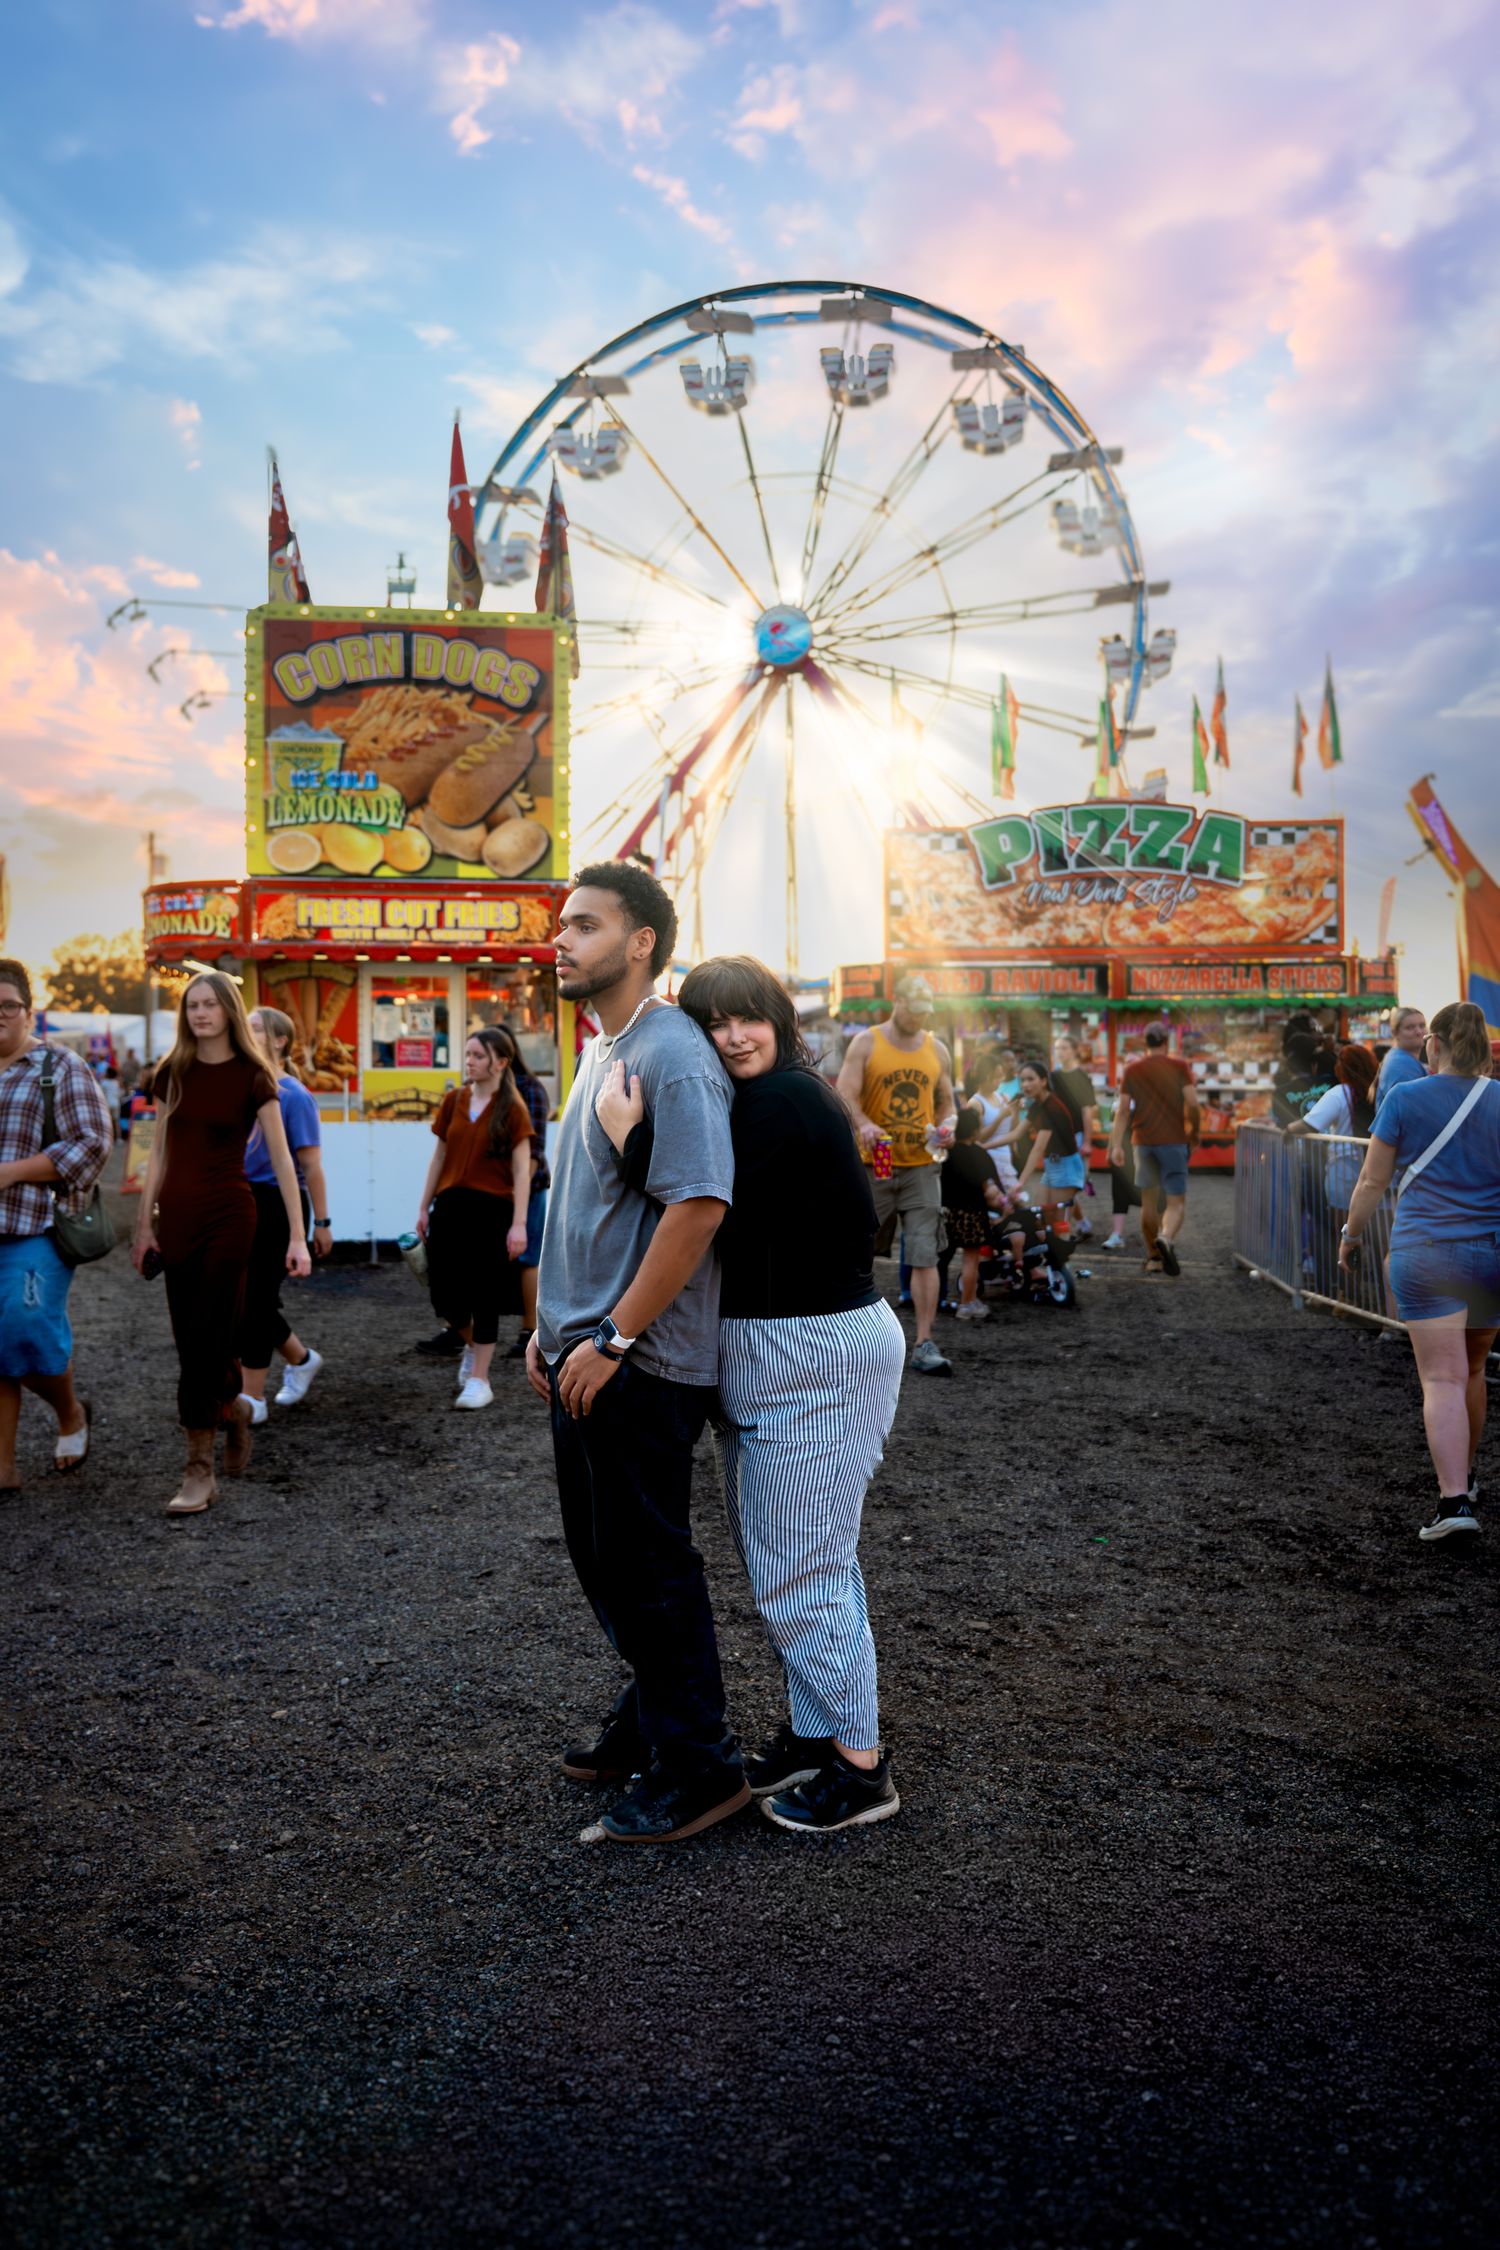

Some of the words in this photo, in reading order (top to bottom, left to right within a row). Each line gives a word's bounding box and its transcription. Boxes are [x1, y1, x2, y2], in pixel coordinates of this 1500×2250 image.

[273, 632, 405, 701] CORN
[411, 633, 541, 708] DOGS
[289, 768, 321, 788] ICE
[265, 794, 405, 829] LEMONADE
[967, 804, 1246, 892] PIZZA
[297, 898, 382, 928] FRESH
[385, 899, 441, 929] CUT
[443, 900, 520, 931] FRIES
[1023, 880, 1070, 906] New
[1075, 880, 1126, 906] York
[1134, 874, 1198, 924] Style
[991, 968, 1097, 994] RAVIOLI
[1131, 966, 1263, 994] MOZZARELLA
[1267, 965, 1343, 991] STICKS
[883, 1069, 929, 1089] NEVER
